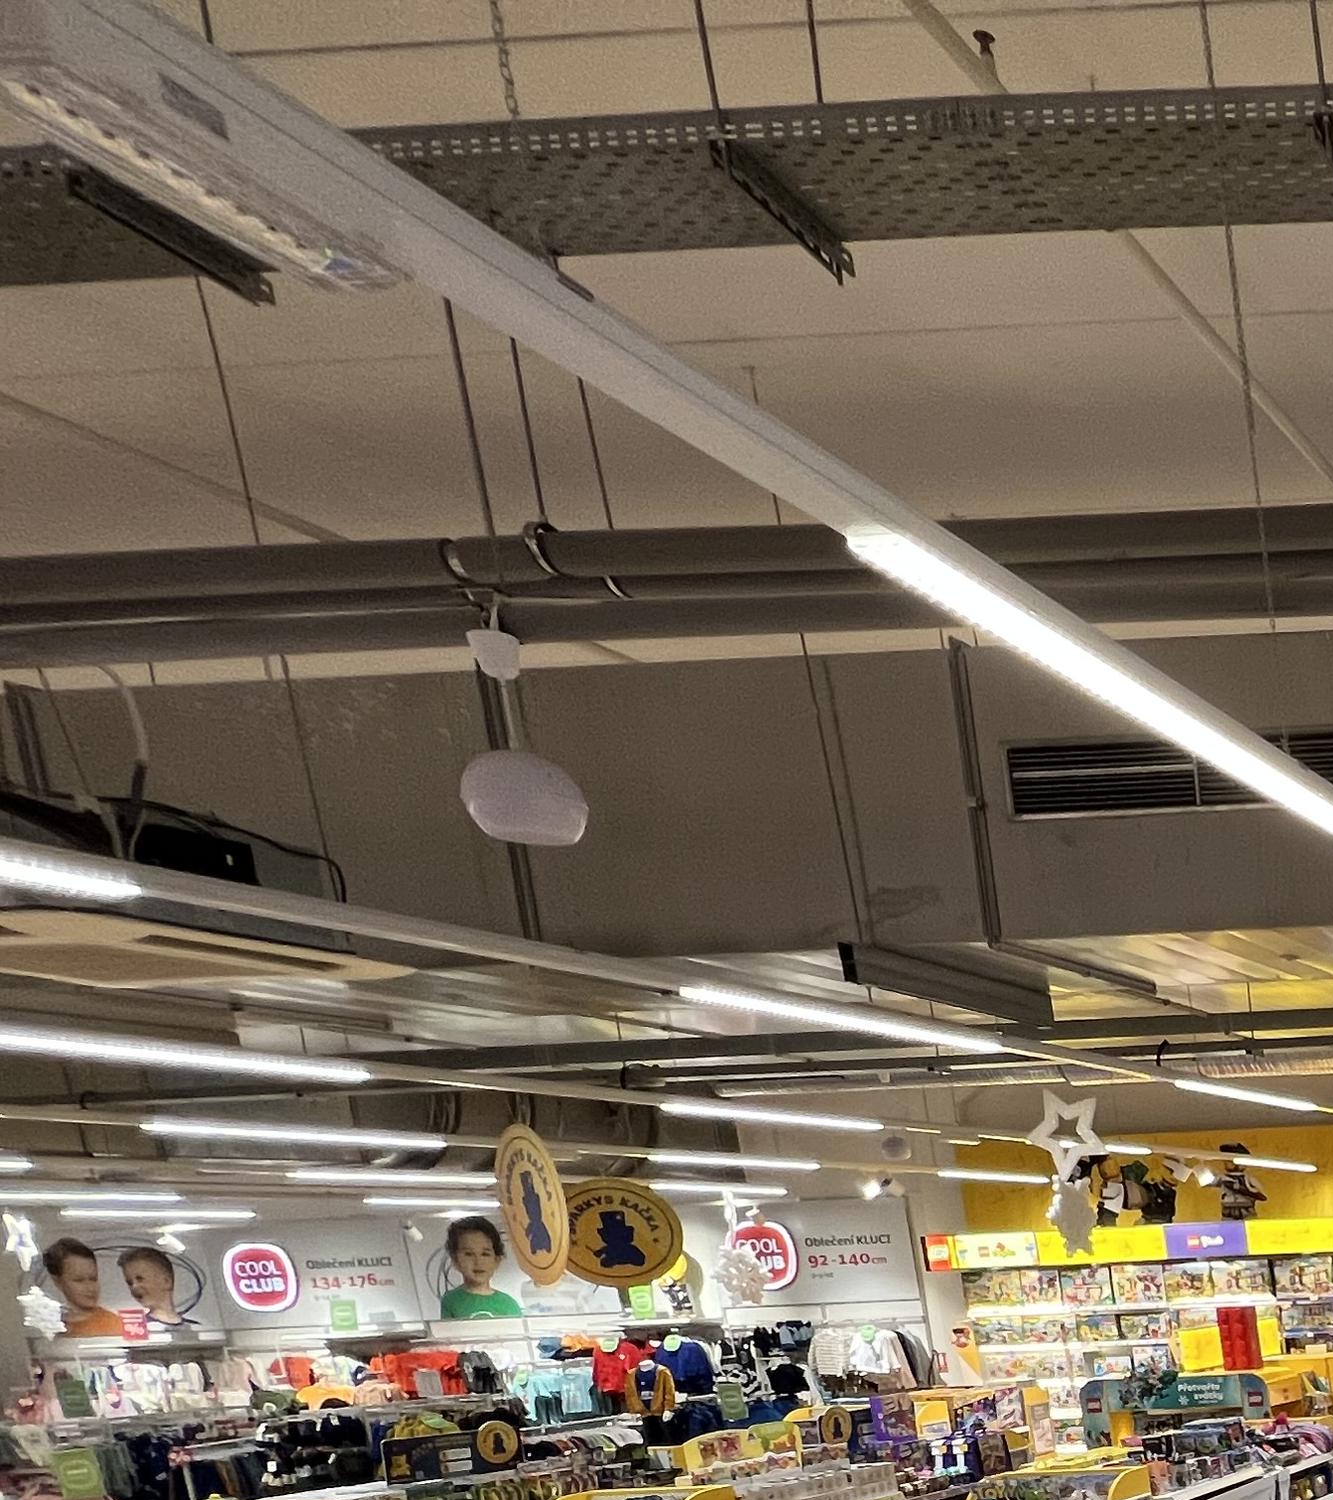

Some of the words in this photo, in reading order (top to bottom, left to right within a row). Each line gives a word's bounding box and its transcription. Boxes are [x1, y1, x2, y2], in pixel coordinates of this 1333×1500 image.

[568, 1194, 615, 1236] SPARKYS
[618, 1195, 660, 1234] KAČKA
[804, 1235, 854, 1248] Oblečení
[856, 1234, 891, 1245] KLUCI
[234, 1259, 283, 1278] COOL
[238, 1276, 286, 1294] CLUB
